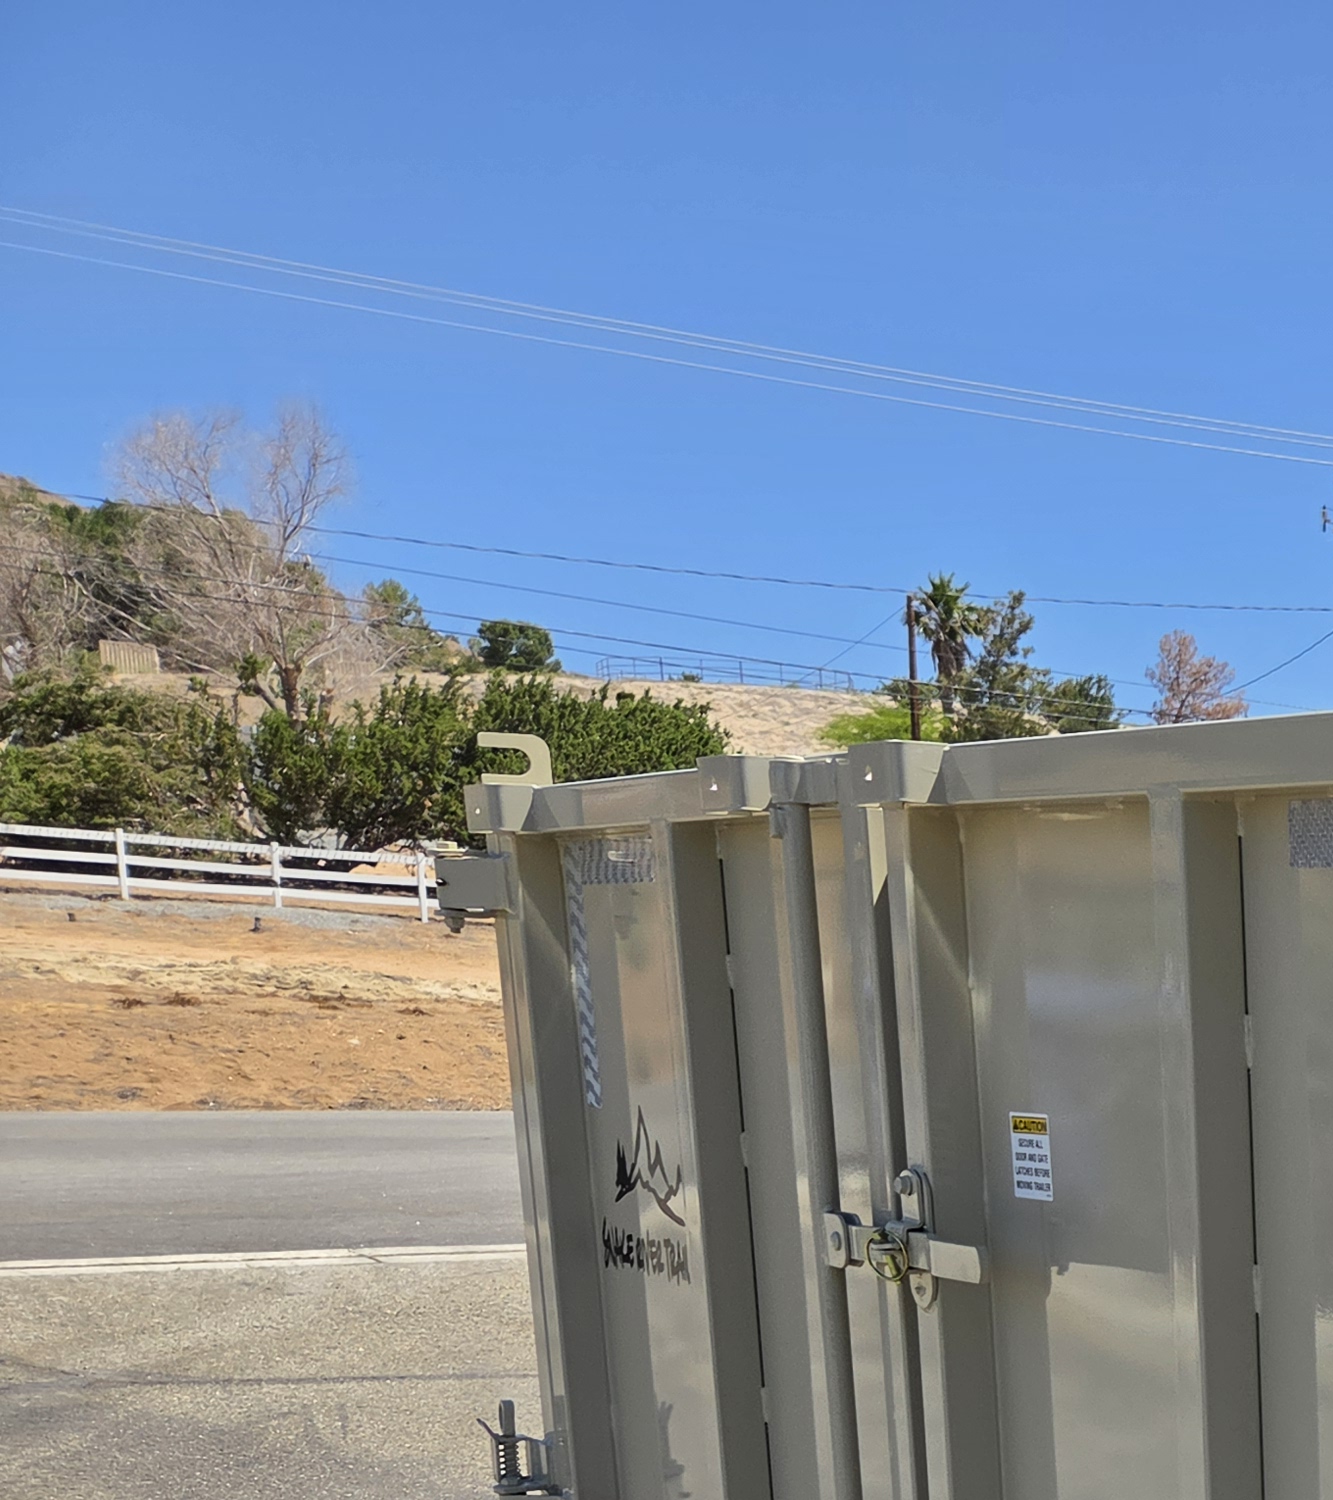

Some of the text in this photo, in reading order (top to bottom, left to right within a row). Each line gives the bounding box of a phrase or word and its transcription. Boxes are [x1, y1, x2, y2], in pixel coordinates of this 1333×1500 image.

[1018, 1119, 1047, 1132] CAUTION
[1018, 1138, 1043, 1149] SECURE ALL
[1015, 1152, 1049, 1164] DOOR AND GATE
[1015, 1166, 1050, 1178] LATCHES BEFORE
[1016, 1180, 1051, 1192] MOVING TRAILER
